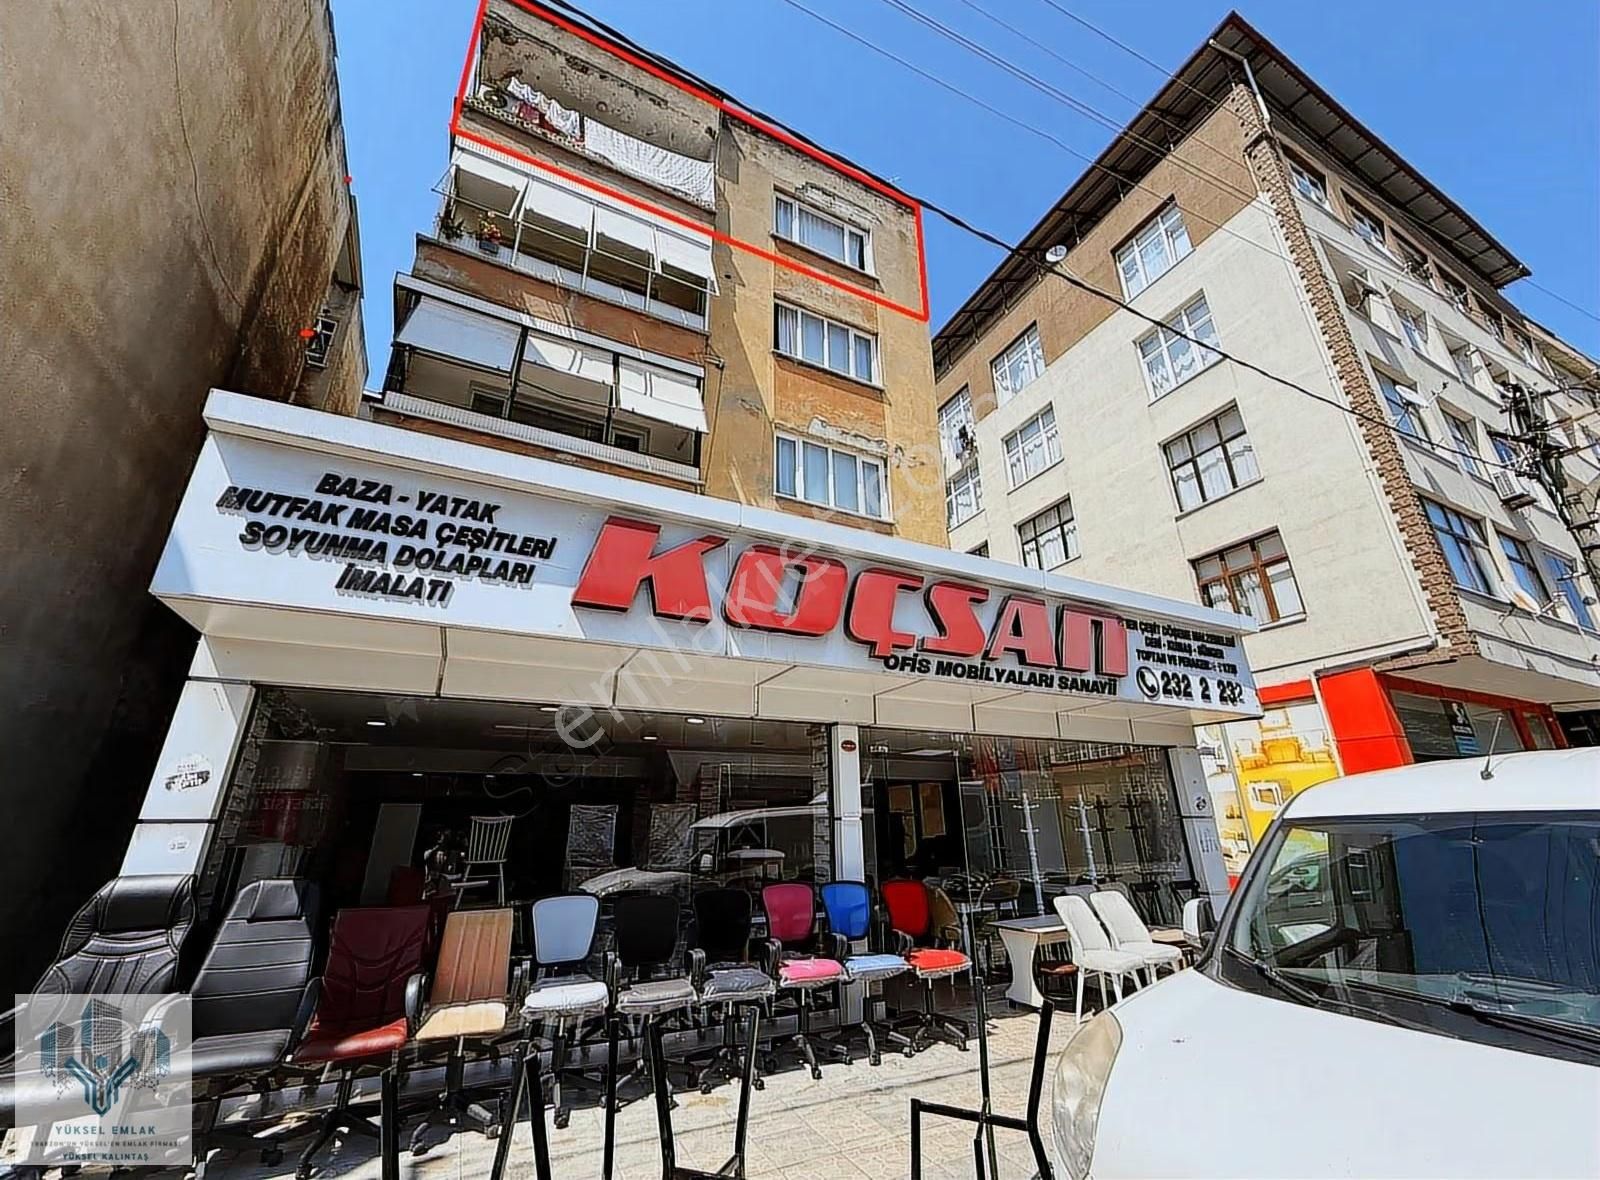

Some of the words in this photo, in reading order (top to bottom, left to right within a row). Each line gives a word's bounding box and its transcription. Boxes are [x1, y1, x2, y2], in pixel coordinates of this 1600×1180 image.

[216, 486, 348, 525] MUTFAK
[347, 509, 428, 540] MASA
[435, 522, 557, 559] ÇEŞİTLERİ
[315, 473, 393, 504] BAZA
[415, 491, 500, 523] YATAK
[239, 521, 389, 565] SOYUNMA
[392, 545, 536, 583] DOLAPLARI
[335, 562, 453, 601] İMALATI
[571, 515, 1129, 678] KOÇSAN
[883, 653, 932, 674] OFİS
[935, 659, 1055, 688] MOBİLYALARI
[1160, 670, 1194, 699] 232
[1199, 676, 1212, 701] 2
